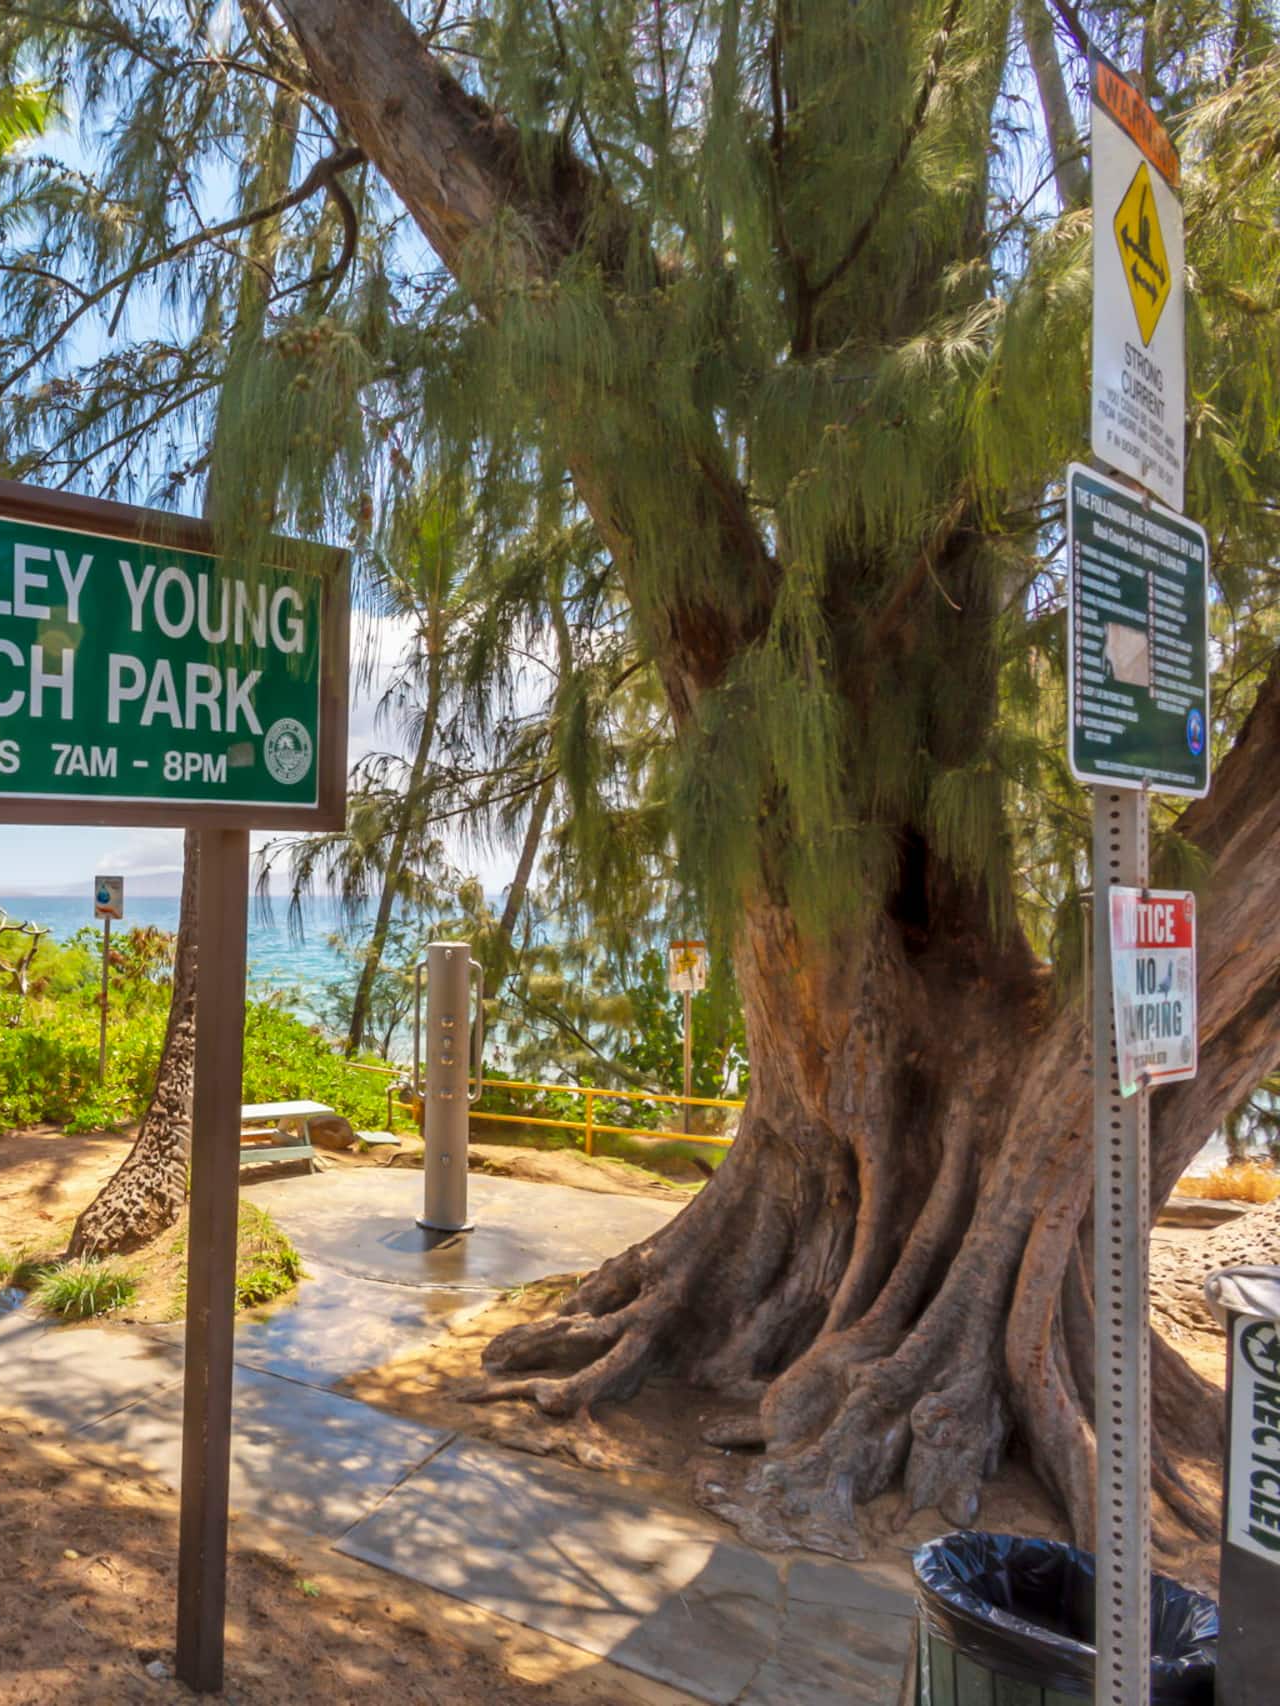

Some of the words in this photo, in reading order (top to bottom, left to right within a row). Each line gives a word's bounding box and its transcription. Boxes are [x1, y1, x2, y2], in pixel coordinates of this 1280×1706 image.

[1124, 341, 1163, 392] STRONG
[119, 560, 304, 654] YOUNG
[108, 653, 263, 735] PARK
[51, 743, 117, 777] 7AM
[163, 750, 227, 783] 8PM
[1135, 957, 1155, 996] NO
